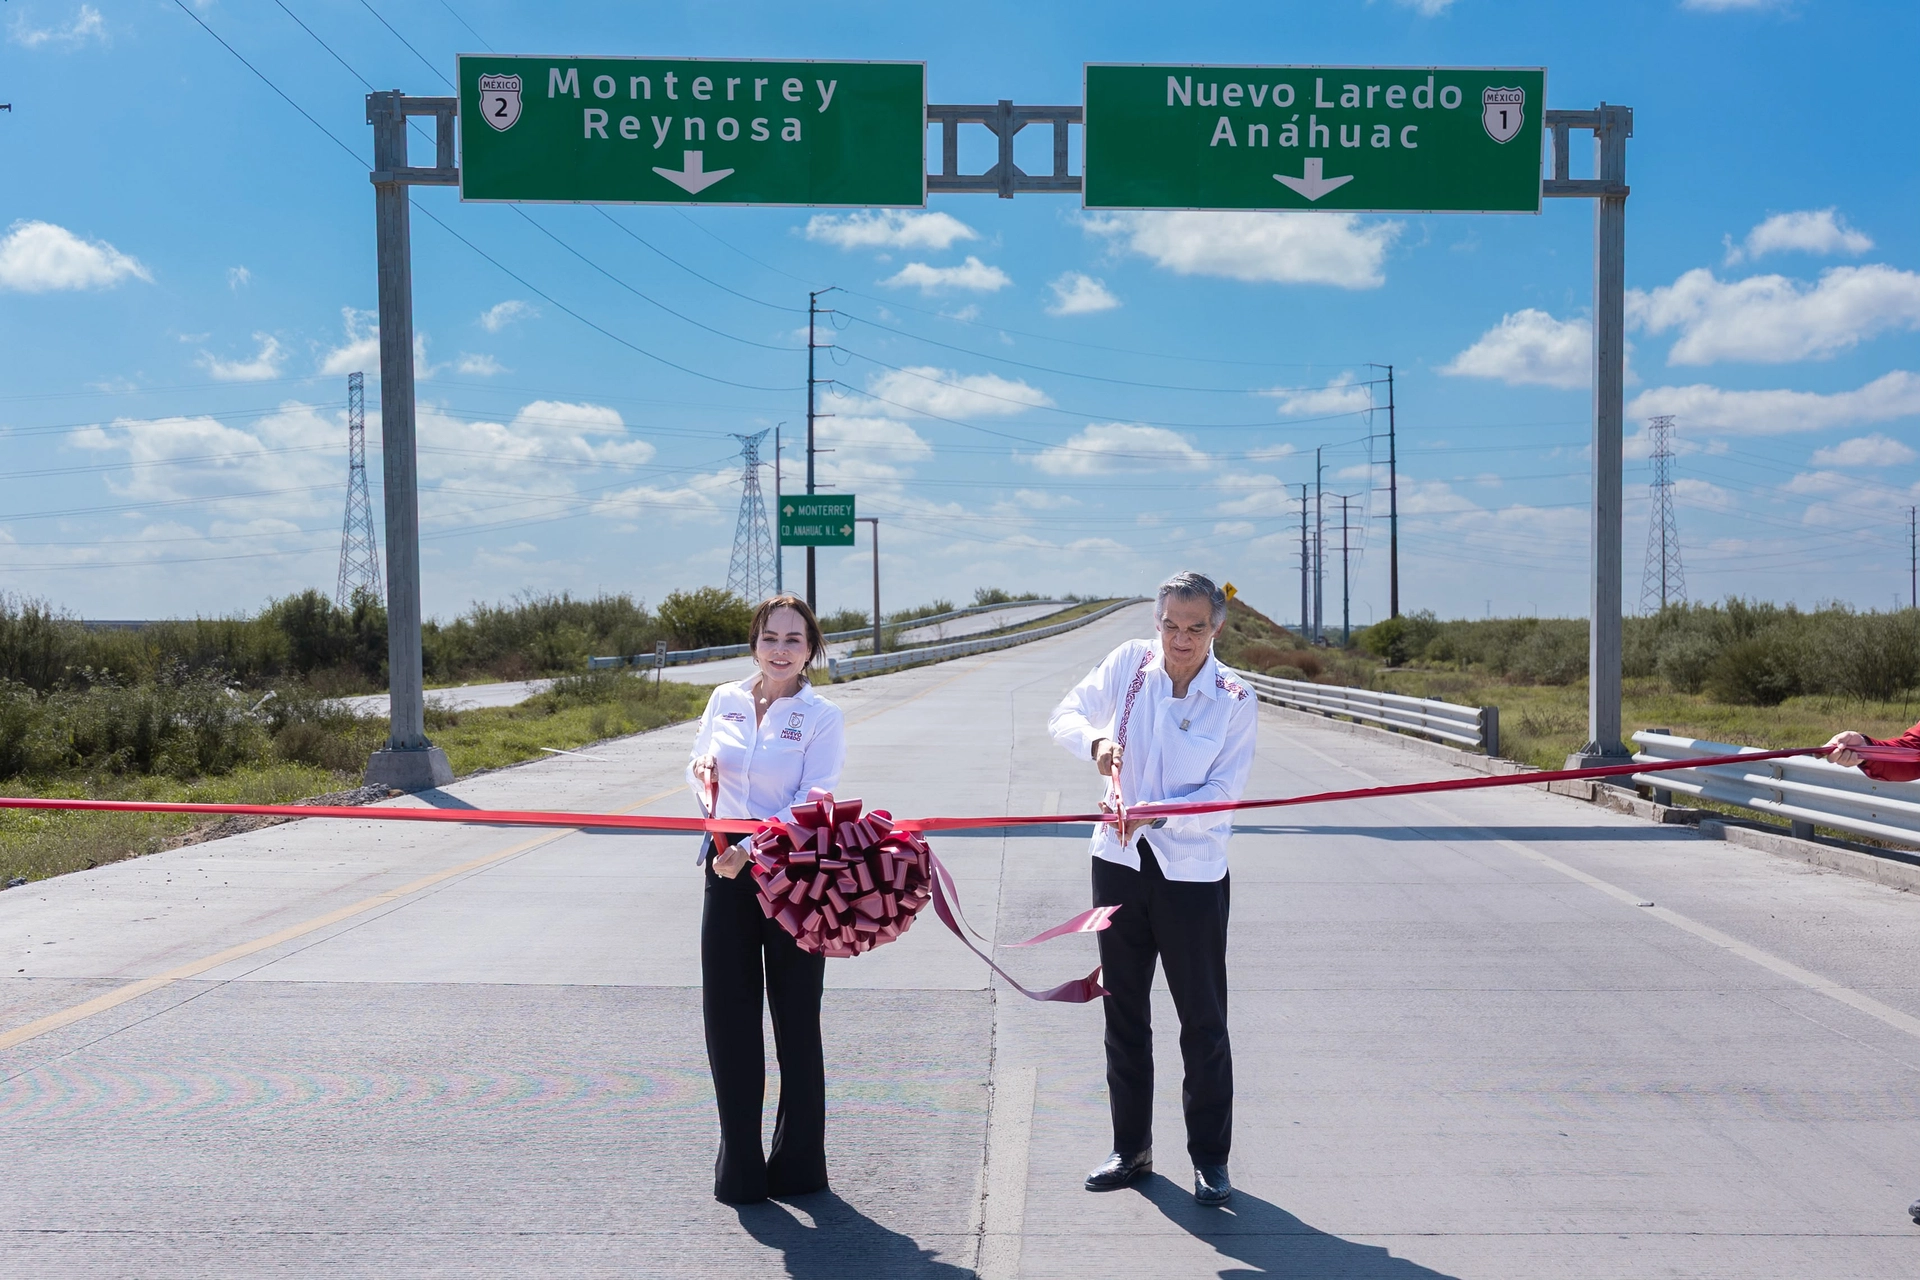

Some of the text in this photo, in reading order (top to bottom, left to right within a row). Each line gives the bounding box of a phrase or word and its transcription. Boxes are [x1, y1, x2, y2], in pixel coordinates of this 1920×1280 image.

[483, 80, 518, 90] MÉXICO
[548, 67, 837, 113] Monterrey
[1167, 75, 1462, 109] Nuevo Laredo
[1486, 92, 1520, 102] MÉXICO
[494, 97, 508, 118] 2
[1499, 110, 1508, 130] 1
[583, 108, 802, 149] Reynosa
[1210, 114, 1418, 149] Anáhuac
[798, 505, 852, 516] MONTERREY
[781, 525, 838, 536] CD. ANAHUAC N.L.
[780, 733, 802, 742] LAREDO
[781, 729, 802, 738] NUEVO
